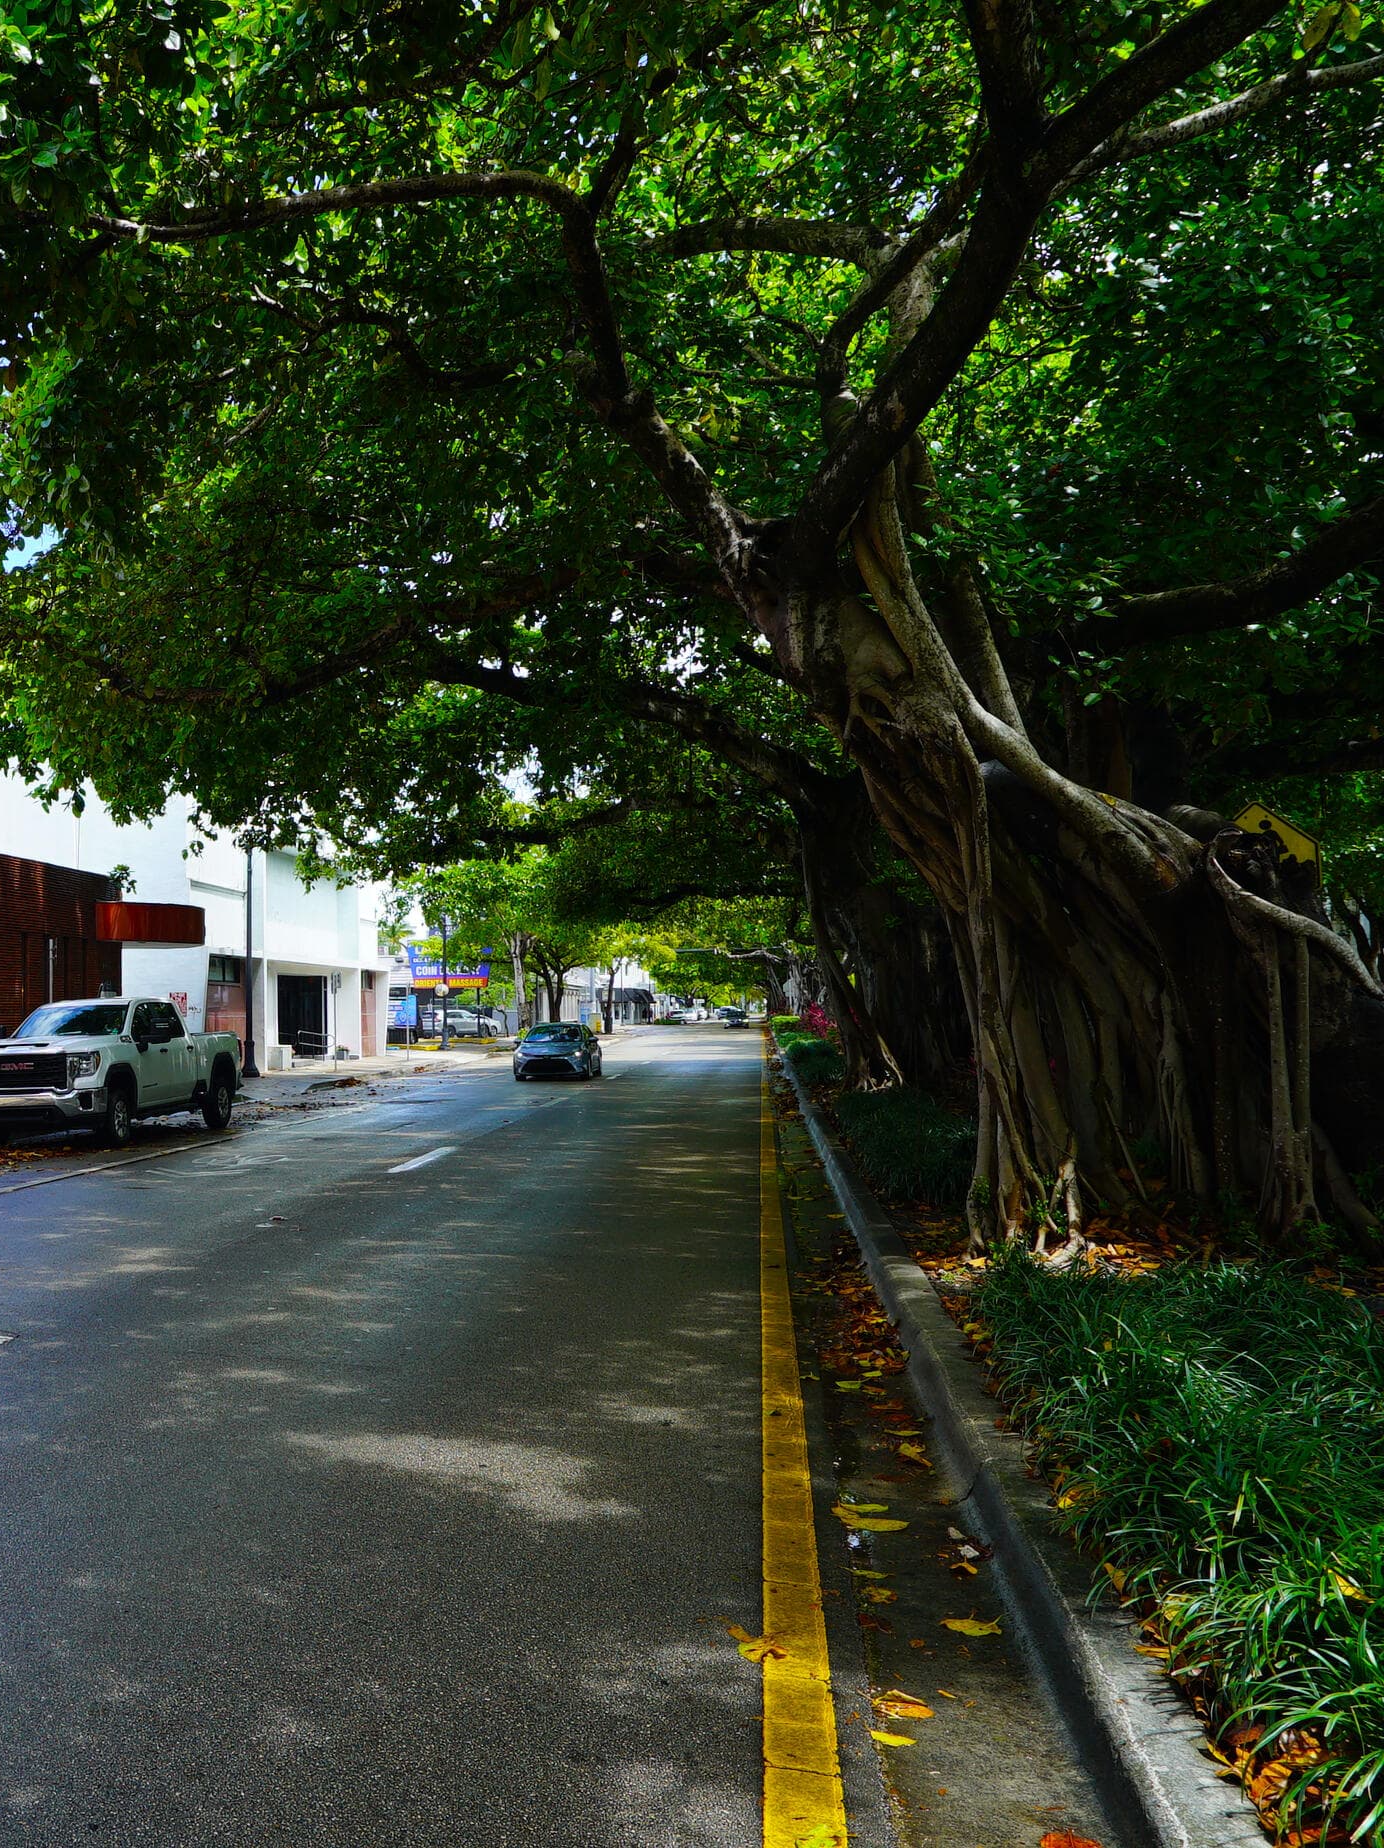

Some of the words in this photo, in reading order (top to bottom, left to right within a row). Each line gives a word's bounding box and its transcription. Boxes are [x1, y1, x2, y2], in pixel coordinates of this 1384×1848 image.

[415, 965, 437, 976] COIN
[414, 979, 444, 988] ORIENT
[449, 979, 484, 987] MASSAGE
[0, 1062, 34, 1071] GMC
